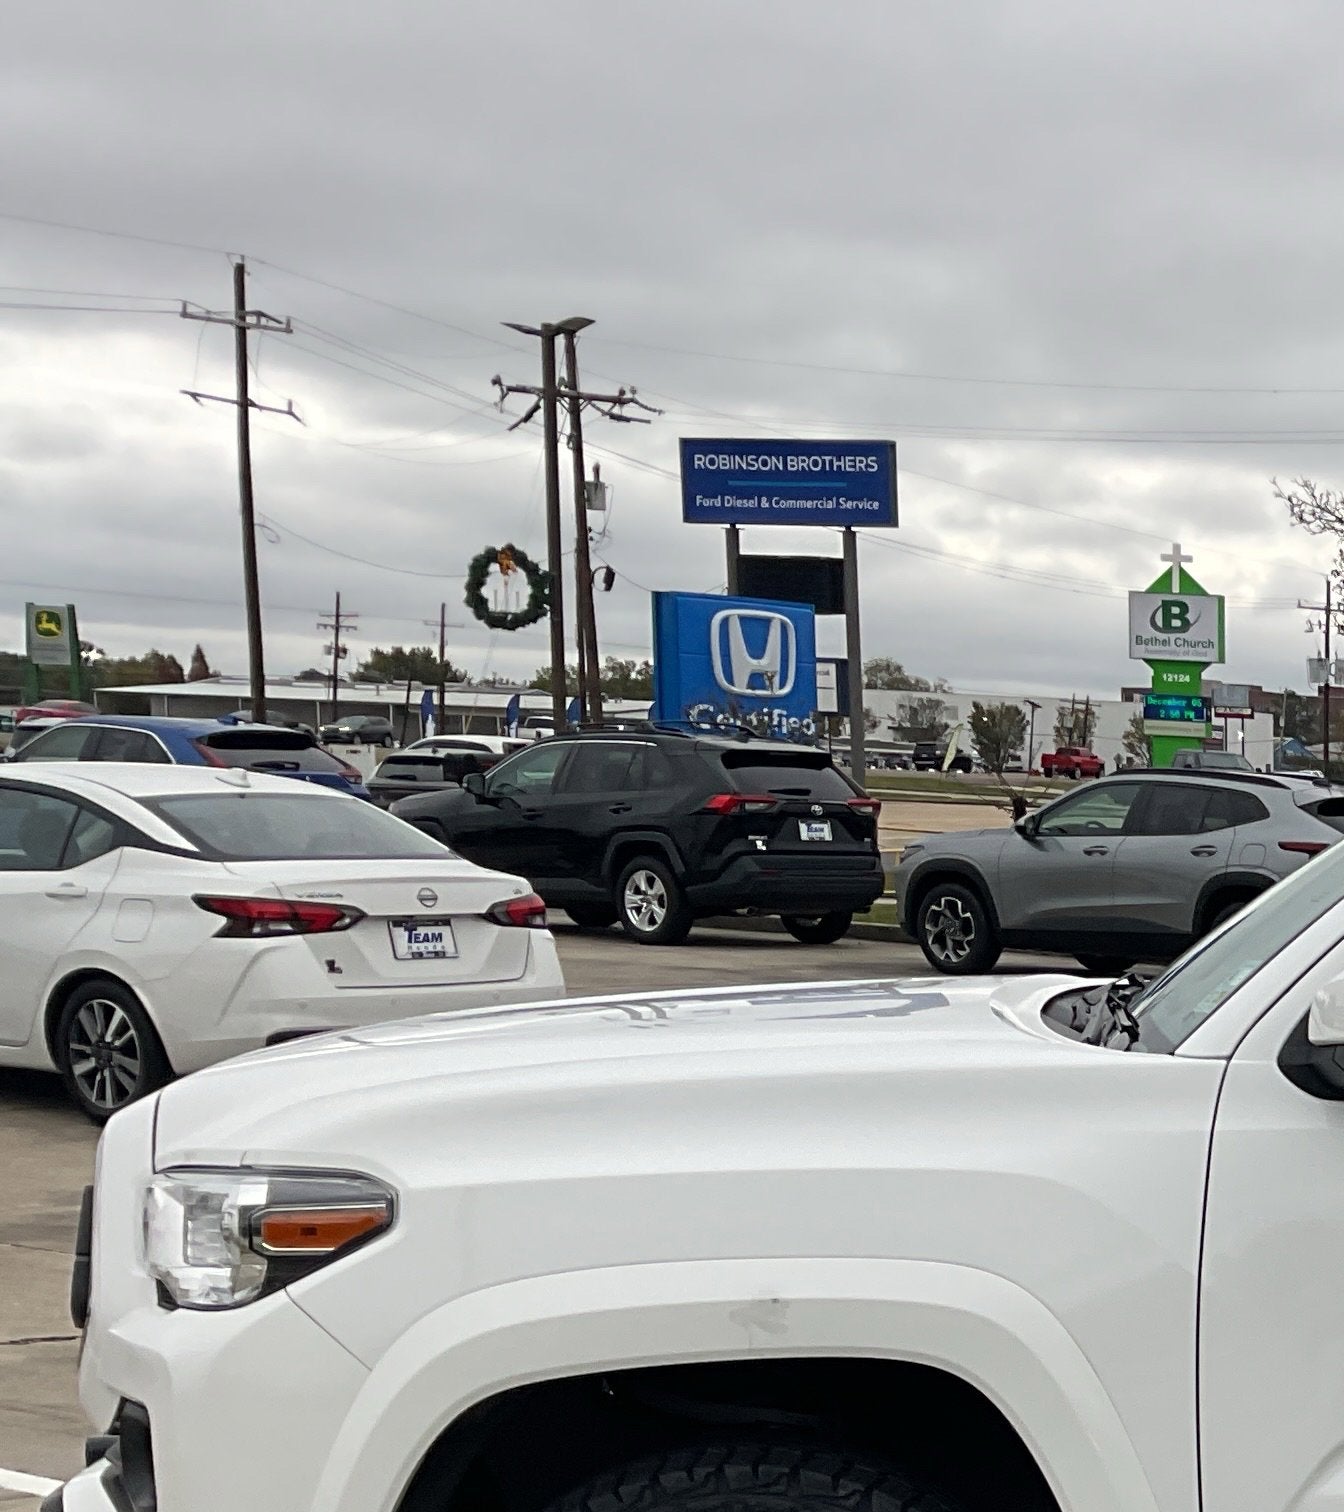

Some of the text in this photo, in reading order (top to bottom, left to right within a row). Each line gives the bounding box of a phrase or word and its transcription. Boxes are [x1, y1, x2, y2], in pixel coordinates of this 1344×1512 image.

[693, 454, 879, 473] ROBINSON BROTHERS
[695, 494, 880, 511] Ford Diesel & Commercial Service
[1161, 599, 1191, 631] B
[1135, 635, 1215, 650] Bethel Church
[1162, 673, 1191, 683] 12124
[405, 927, 443, 943] TEAM
